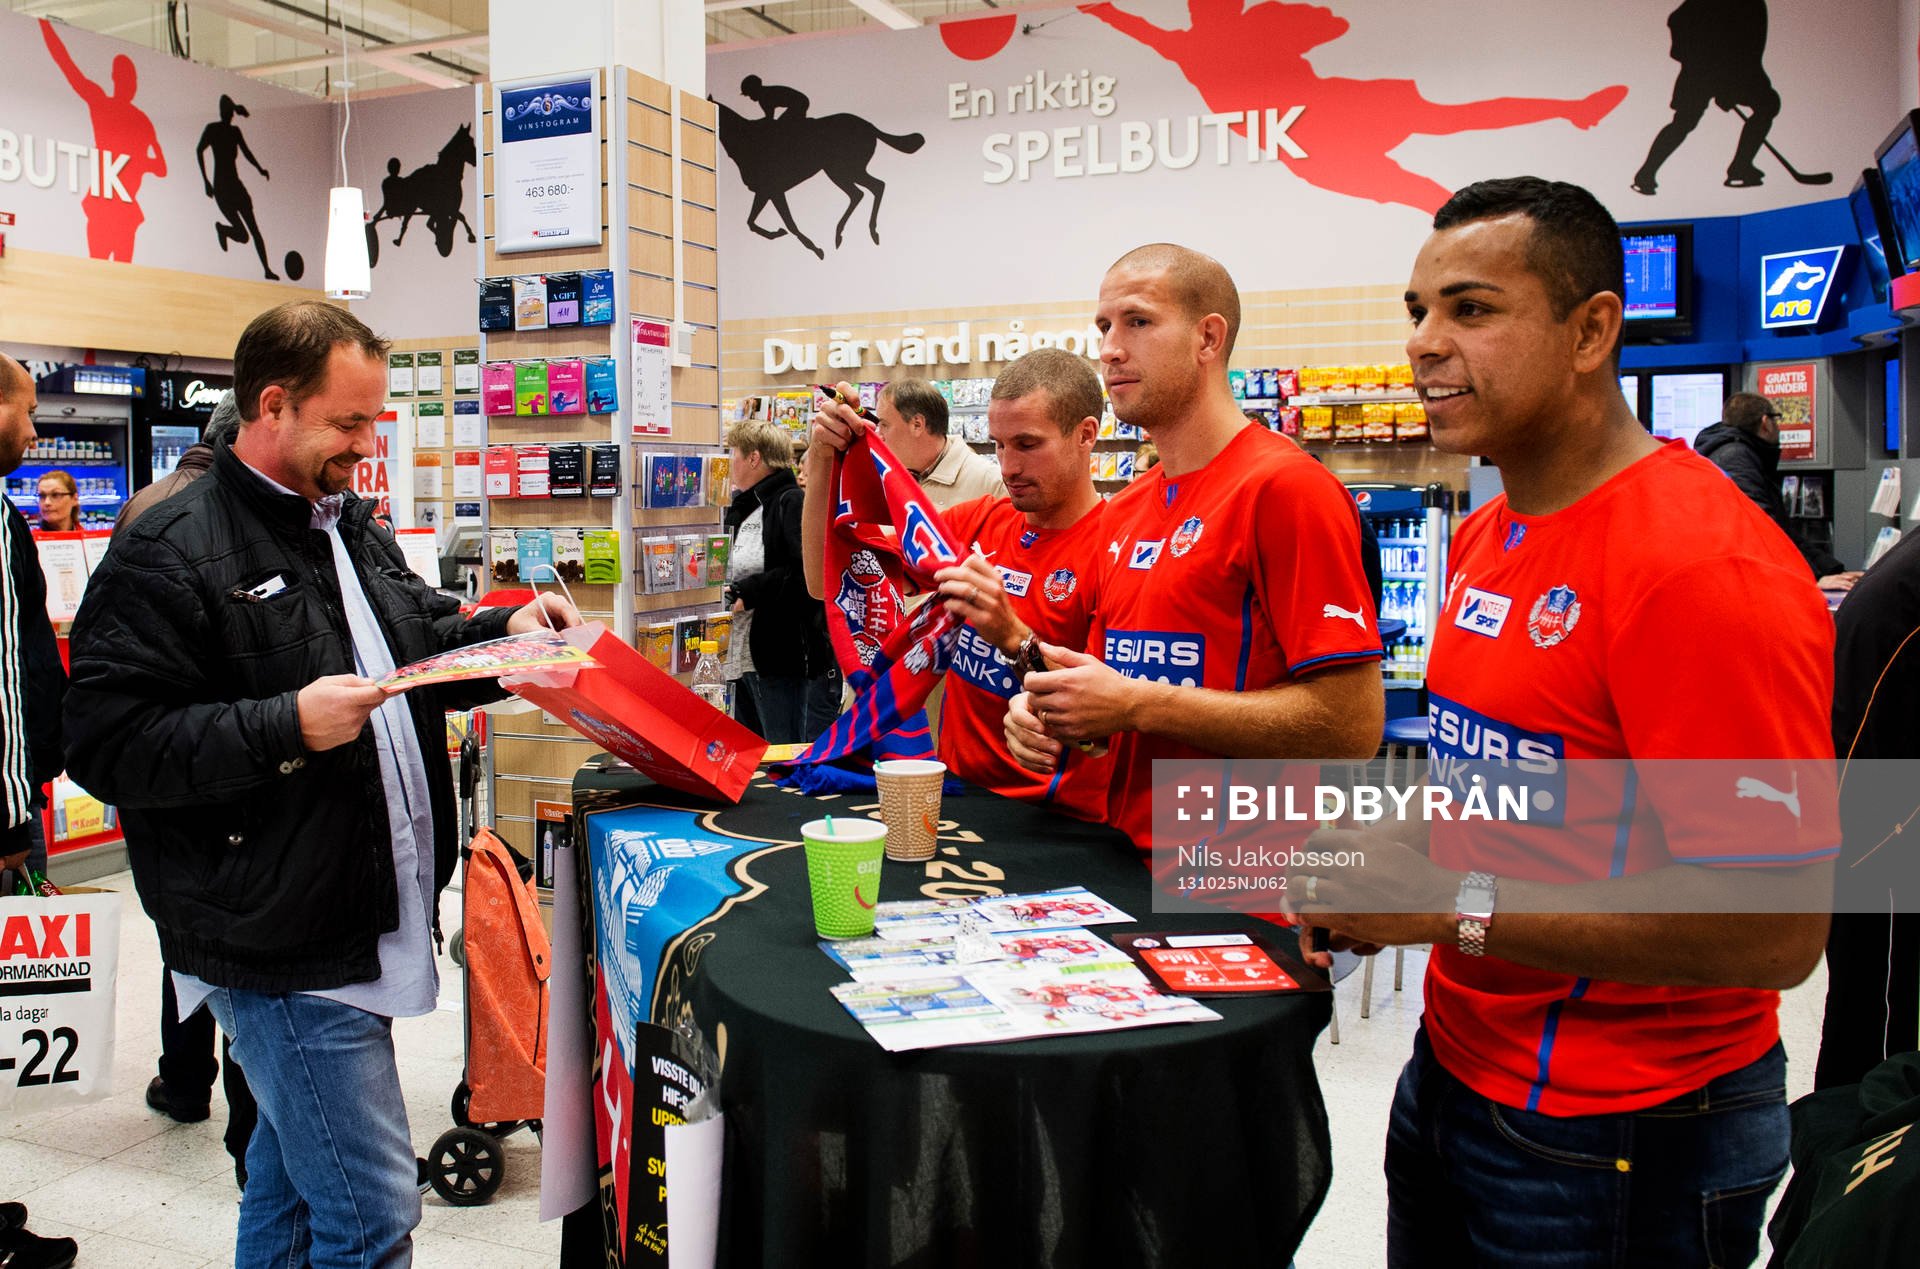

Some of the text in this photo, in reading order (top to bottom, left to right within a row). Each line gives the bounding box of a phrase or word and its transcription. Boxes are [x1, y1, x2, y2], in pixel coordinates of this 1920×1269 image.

[947, 68, 1117, 120] En riktig
[518, 117, 580, 131] VINSTOGRAM
[983, 105, 1309, 185] SPELBUTIK
[525, 186, 545, 198] 463
[559, 291, 577, 300] GIFT
[1770, 300, 1813, 318] ATG
[763, 337, 817, 375] Du
[828, 331, 868, 369] är
[876, 320, 970, 368] värd
[1765, 371, 1806, 384] GRATTIS
[1764, 381, 1808, 394] KUNDER!
[1005, 582, 1025, 592] SPORT
[0, 913, 91, 961] AXI
[0, 961, 92, 981] RMARKNAD
[16, 1005, 49, 1024] dagar
[651, 1055, 689, 1089] VISSTE
[689, 1074, 701, 1097] DU
